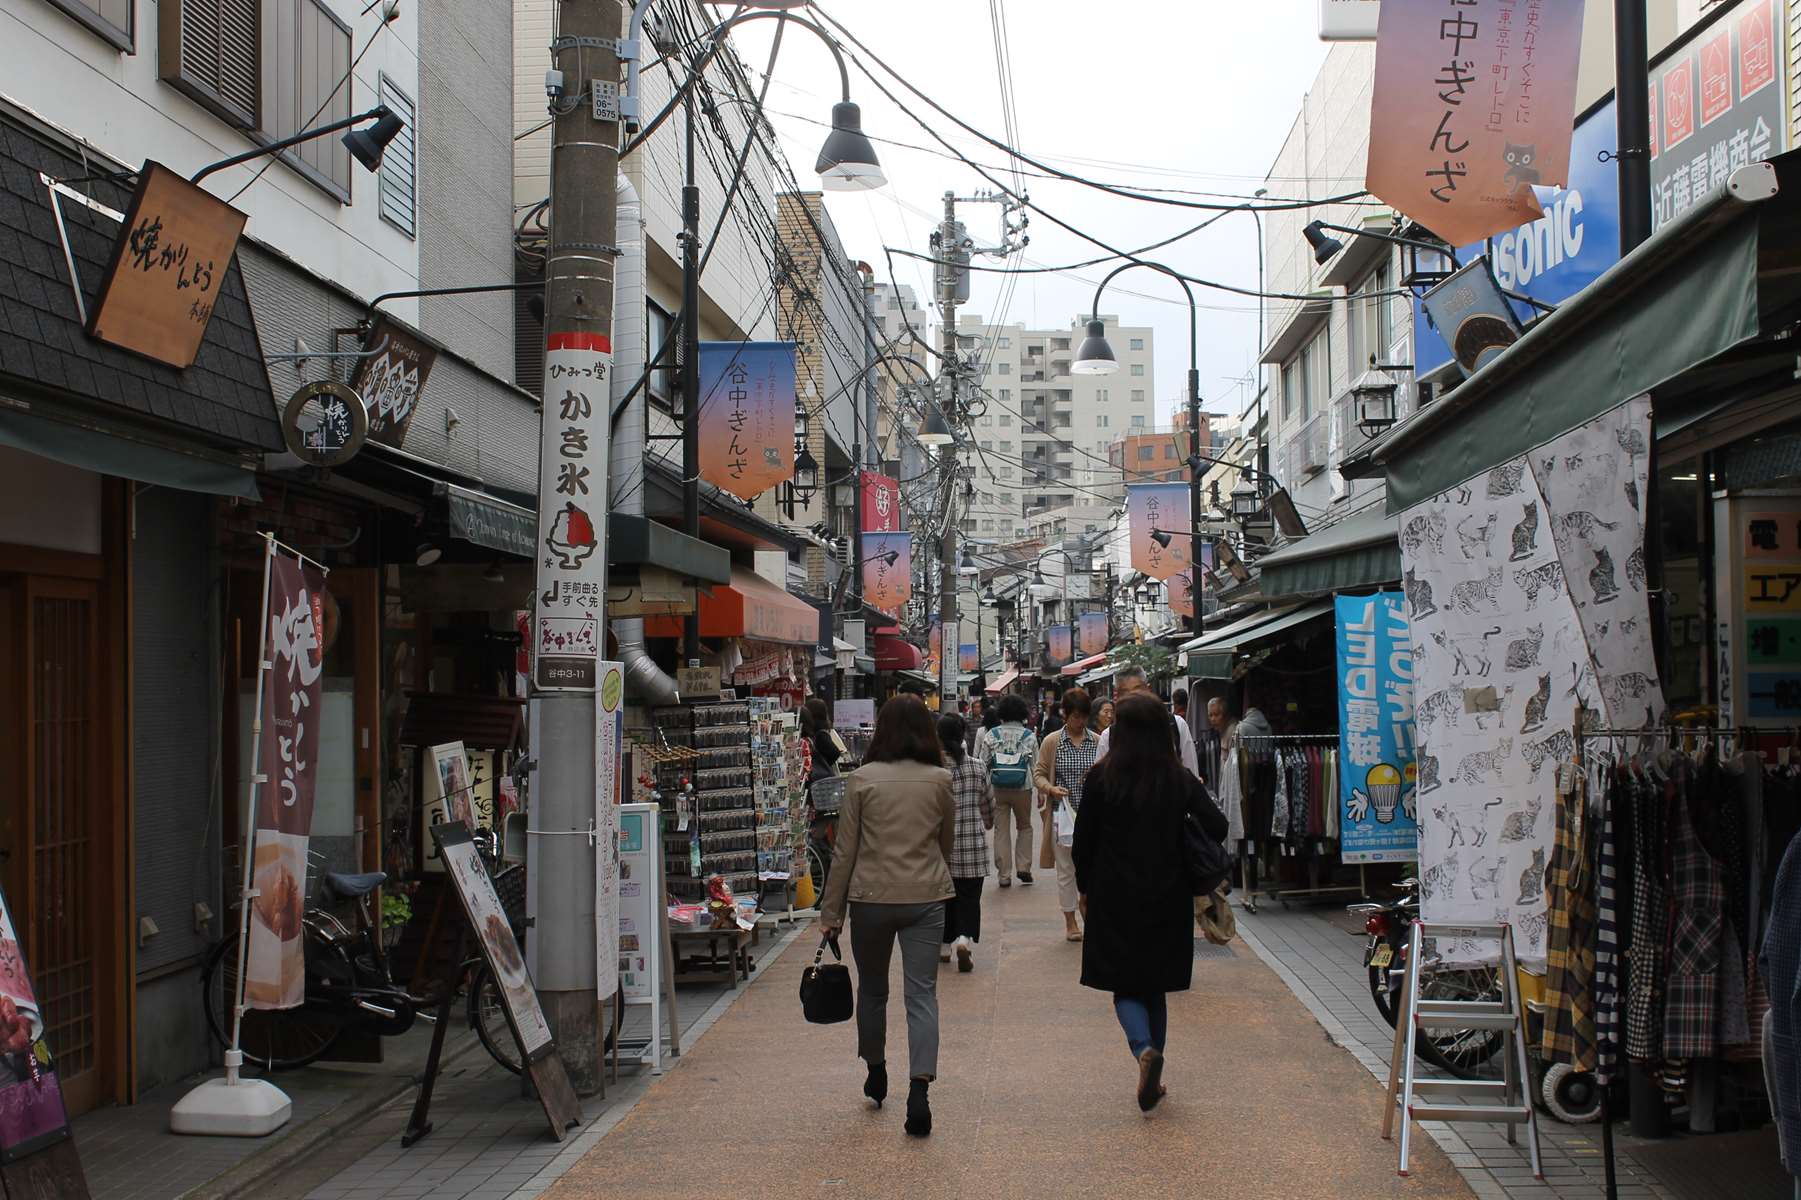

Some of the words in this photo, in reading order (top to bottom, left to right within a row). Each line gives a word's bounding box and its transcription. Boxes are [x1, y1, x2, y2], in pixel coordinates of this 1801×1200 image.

[1490, 186, 1584, 293] sonic
[549, 360, 606, 381] ひみつ堂
[555, 389, 592, 497] かき氷
[727, 361, 749, 480] 谷中ぎんざ
[562, 581, 599, 595] 手前曲る
[562, 595, 598, 608] すぐ先
